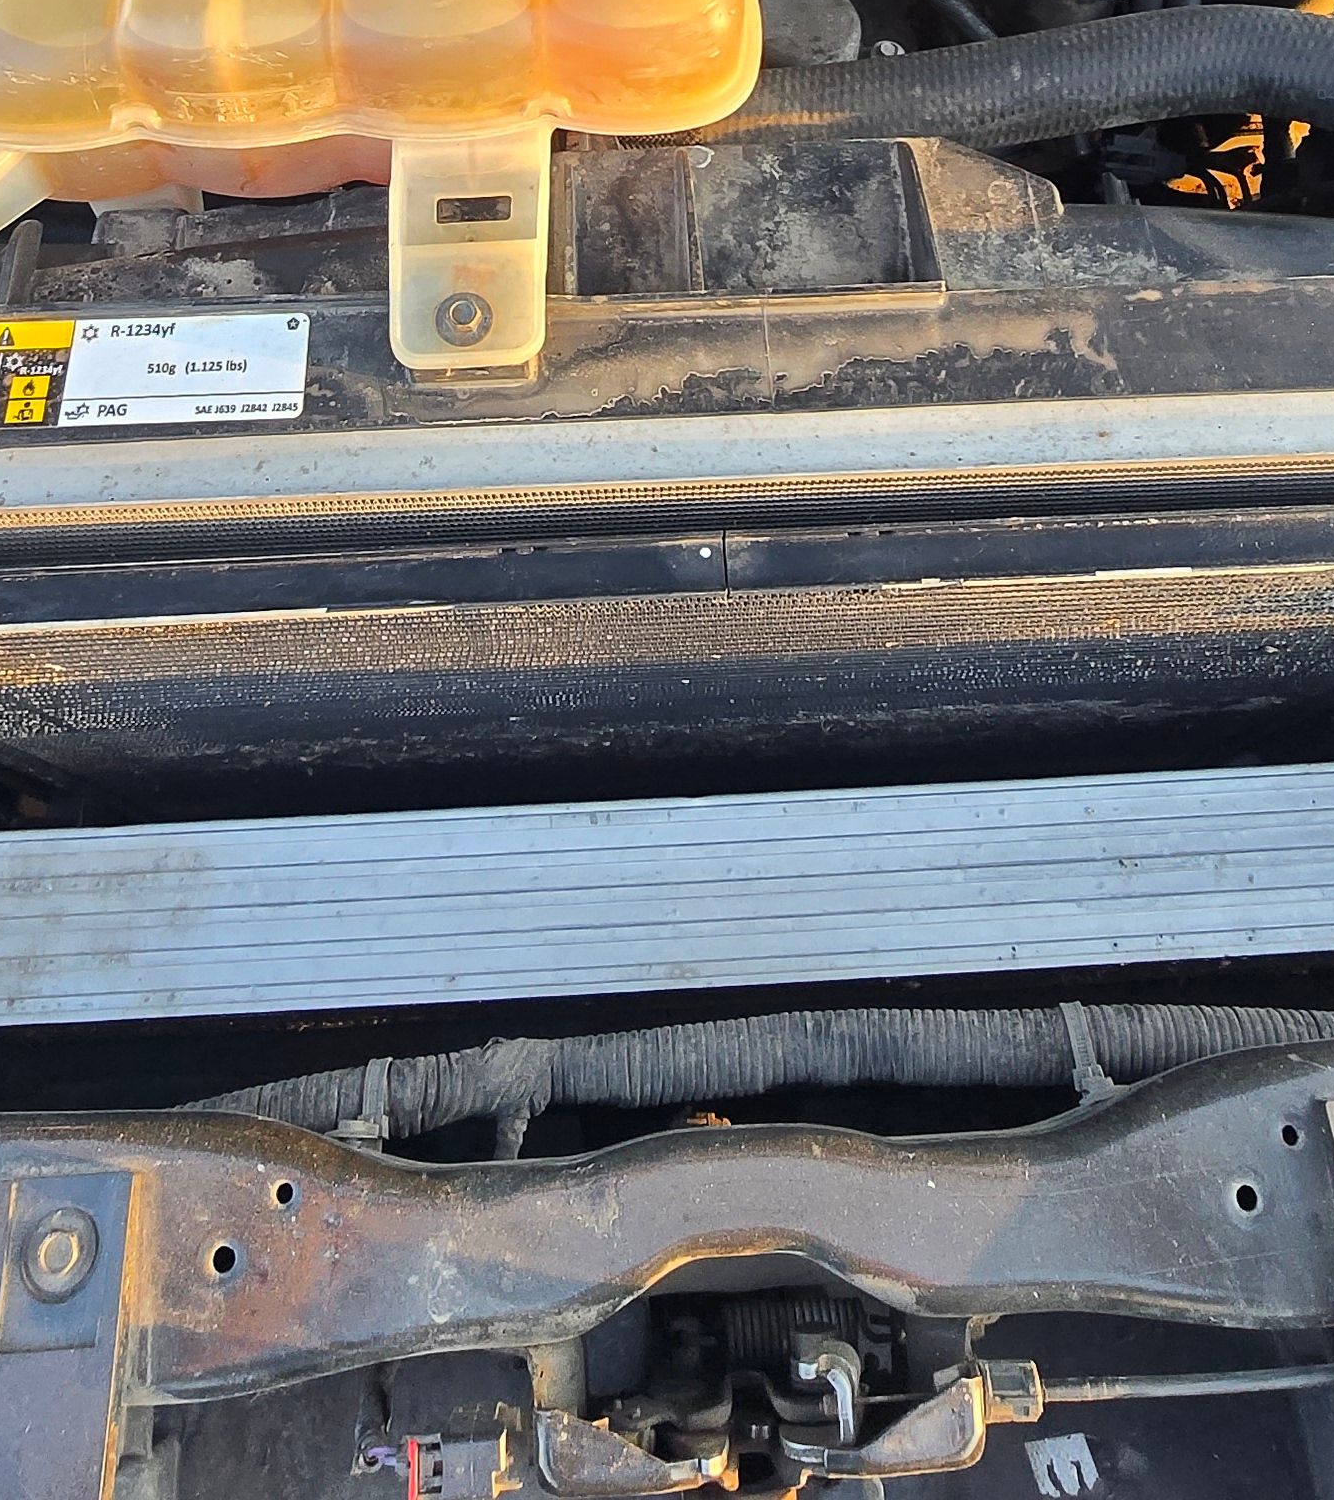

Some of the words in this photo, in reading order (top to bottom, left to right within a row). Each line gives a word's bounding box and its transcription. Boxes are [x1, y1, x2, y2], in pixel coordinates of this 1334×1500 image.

[111, 323, 176, 338] R-1234yf
[147, 362, 177, 376] 510g
[185, 361, 223, 375] (1.125
[225, 359, 248, 373] lbs)
[97, 404, 128, 417] PAG
[195, 406, 212, 415] SAE
[214, 405, 236, 415] J639
[240, 404, 268, 414] J2842
[271, 403, 299, 412] J2845
